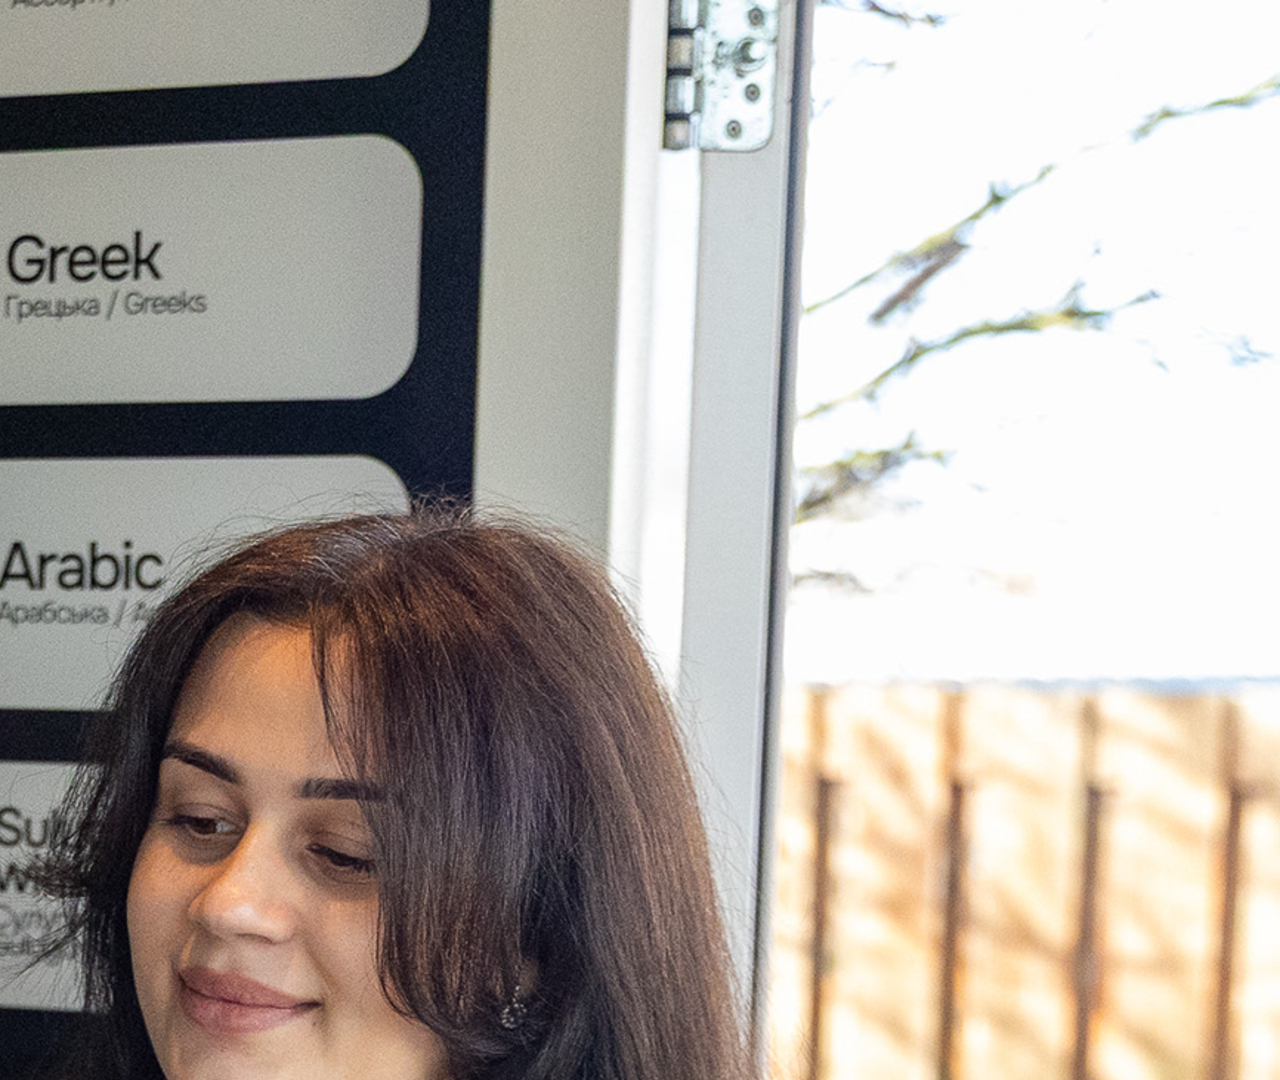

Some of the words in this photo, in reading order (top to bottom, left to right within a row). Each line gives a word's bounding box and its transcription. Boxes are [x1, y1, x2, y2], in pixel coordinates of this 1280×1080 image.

[8, 230, 162, 285] Greek
[4, 294, 101, 323] Грецька
[105, 289, 120, 321] /
[123, 290, 208, 316] Greeks
